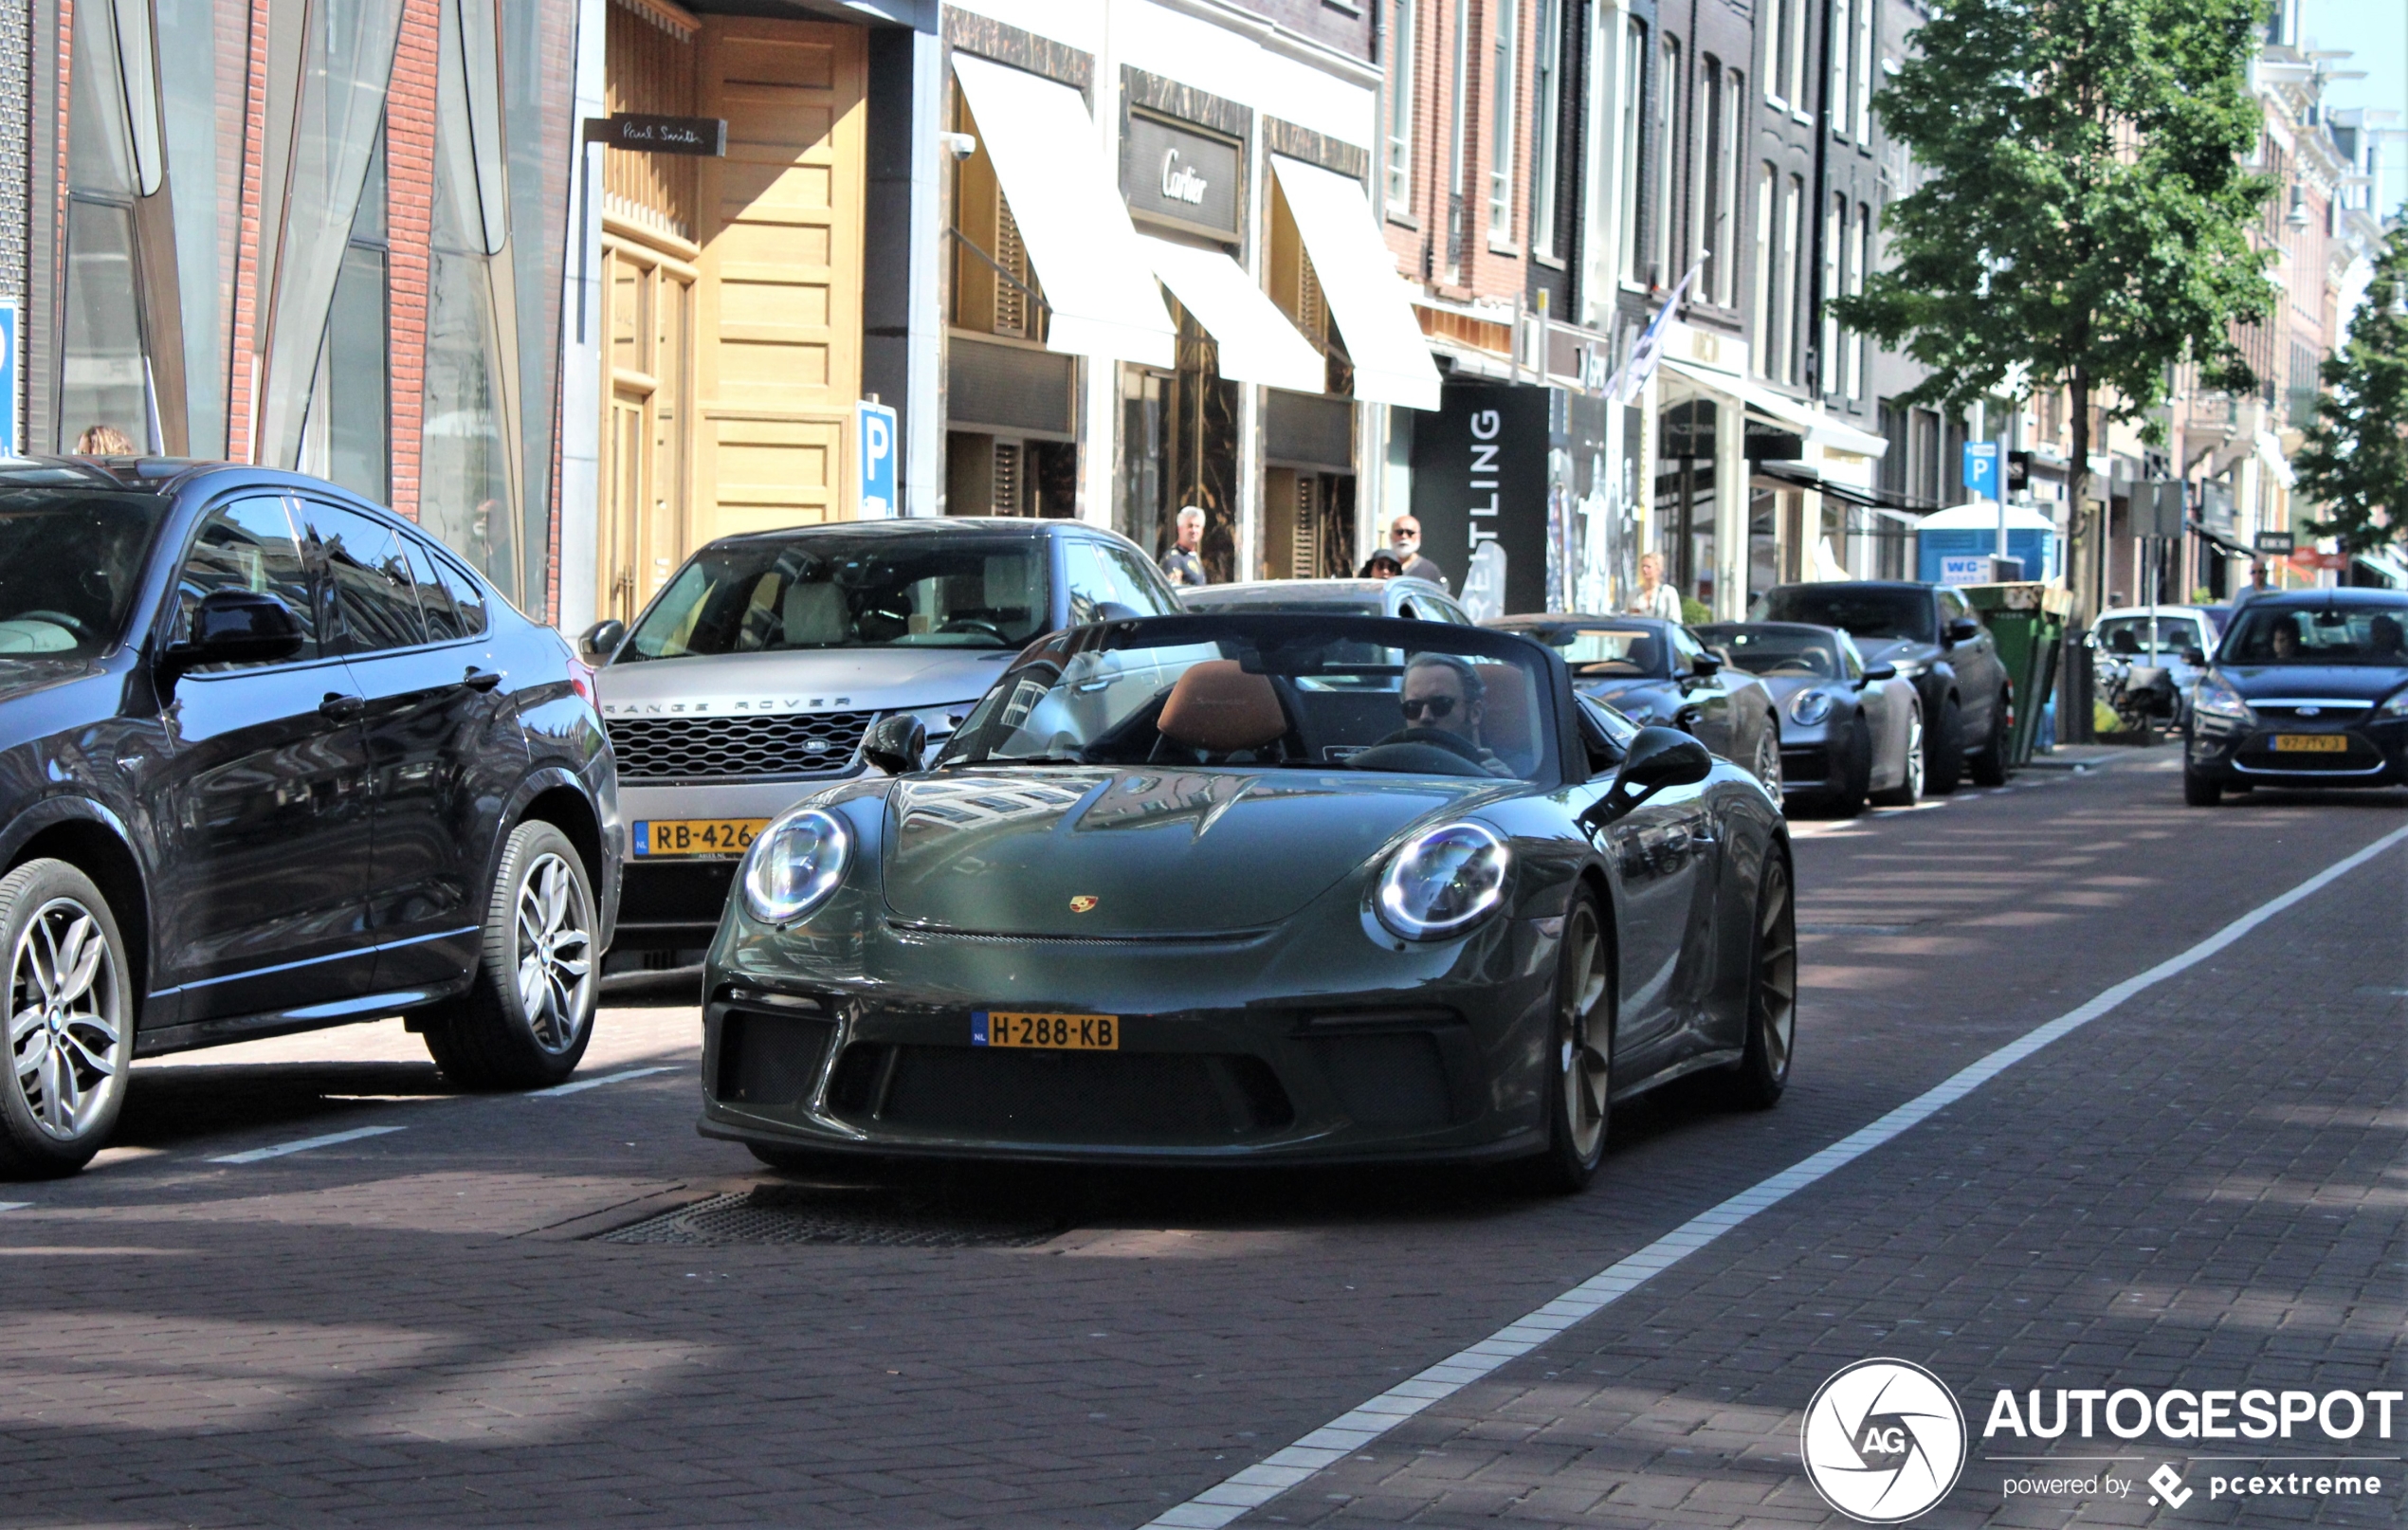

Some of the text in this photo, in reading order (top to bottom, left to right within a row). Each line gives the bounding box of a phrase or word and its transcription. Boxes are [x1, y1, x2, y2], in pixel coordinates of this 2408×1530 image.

[623, 120, 704, 144] Paul Smith
[1162, 148, 1208, 205] Cartier
[867, 415, 889, 481] P
[1973, 458, 1989, 483] P
[1466, 410, 1501, 625] REITLING
[603, 698, 851, 714] RANGE ROVER
[636, 824, 758, 849] NL RB-426-
[974, 1016, 1113, 1047] NL H-288-KB
